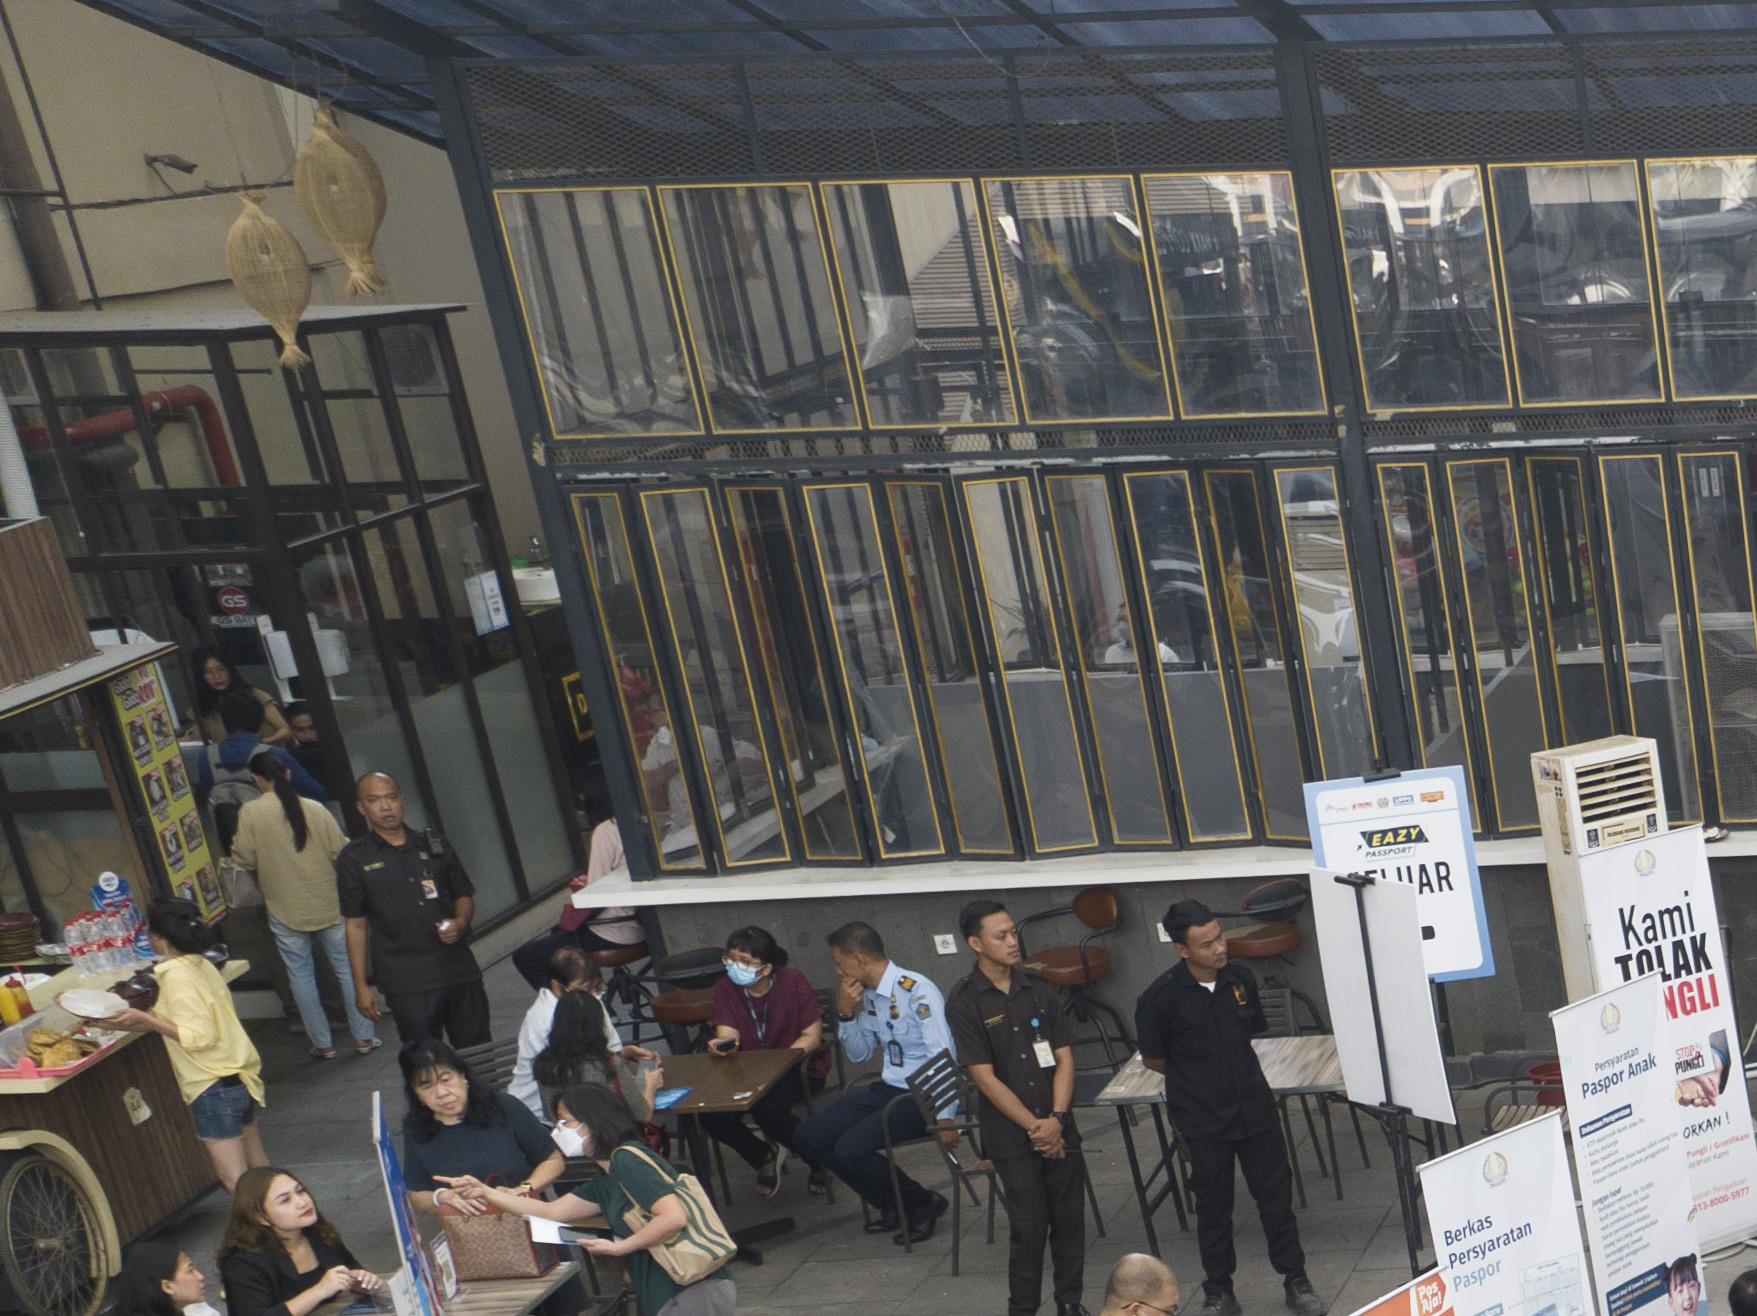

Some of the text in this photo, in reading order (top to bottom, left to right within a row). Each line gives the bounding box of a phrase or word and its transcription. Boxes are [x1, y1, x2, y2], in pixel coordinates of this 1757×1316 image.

[1371, 826, 1421, 847] EAZY
[1365, 846, 1413, 858] PASSPORT
[1619, 891, 1694, 949] Kami
[1615, 934, 1711, 982] TOLAK
[1664, 974, 1719, 1018] NGLI
[1595, 1047, 1639, 1072] Persyaratan
[1675, 1045, 1696, 1060] STOP
[1582, 1053, 1656, 1098] Paspor Anak
[1683, 1111, 1730, 1138] ORKAN !
[1686, 1133, 1749, 1158] Pungli Gratifikasi
[1444, 1216, 1492, 1246] Berkas
[1449, 1223, 1531, 1268] Persyaratan
[1453, 1260, 1500, 1291] Paspor
[1417, 1281, 1439, 1298] Pos
[1421, 1292, 1443, 1314] Aja!
